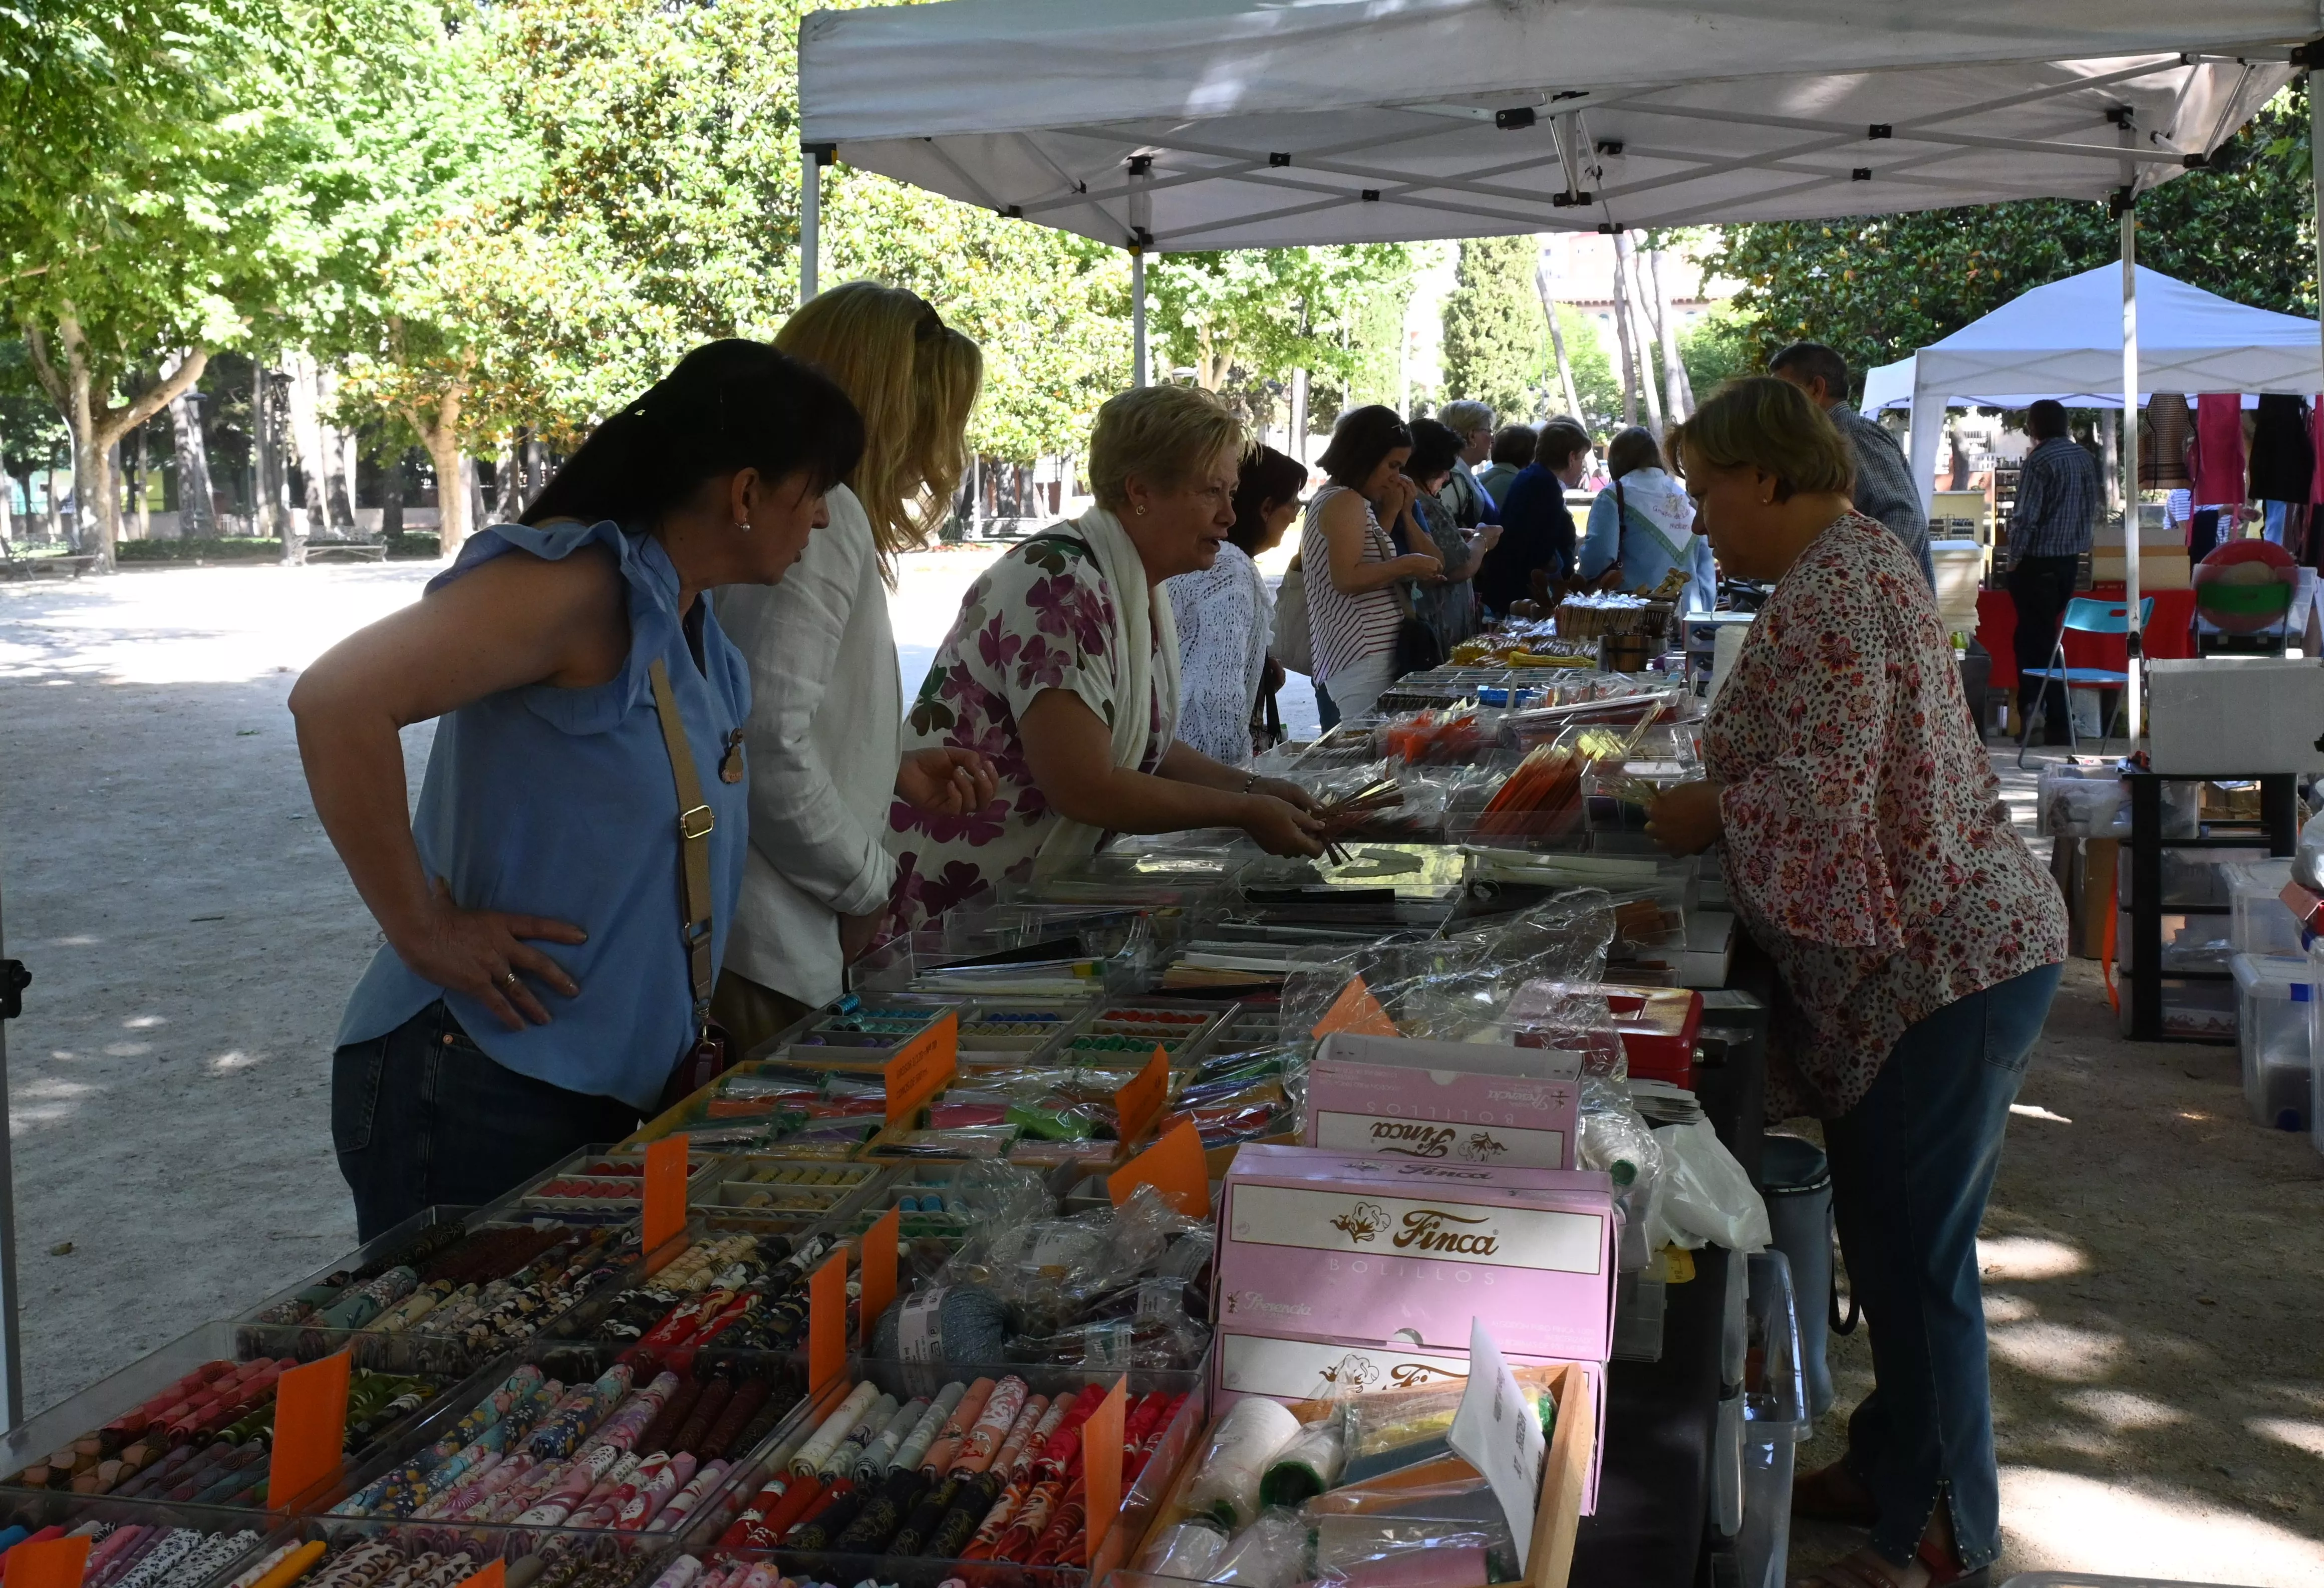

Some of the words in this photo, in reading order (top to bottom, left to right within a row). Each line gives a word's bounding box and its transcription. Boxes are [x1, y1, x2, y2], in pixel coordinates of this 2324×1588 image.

[1487, 1090, 1549, 1111] Presencia
[1366, 1101, 1515, 1126] BOLILLOS
[1370, 1121, 1456, 1159] Finca
[1397, 1164, 1494, 1180] Finca
[1392, 1209, 1499, 1256] Finca
[1329, 1258, 1495, 1285] BOLILLOS
[1243, 1291, 1312, 1316] Presencia
